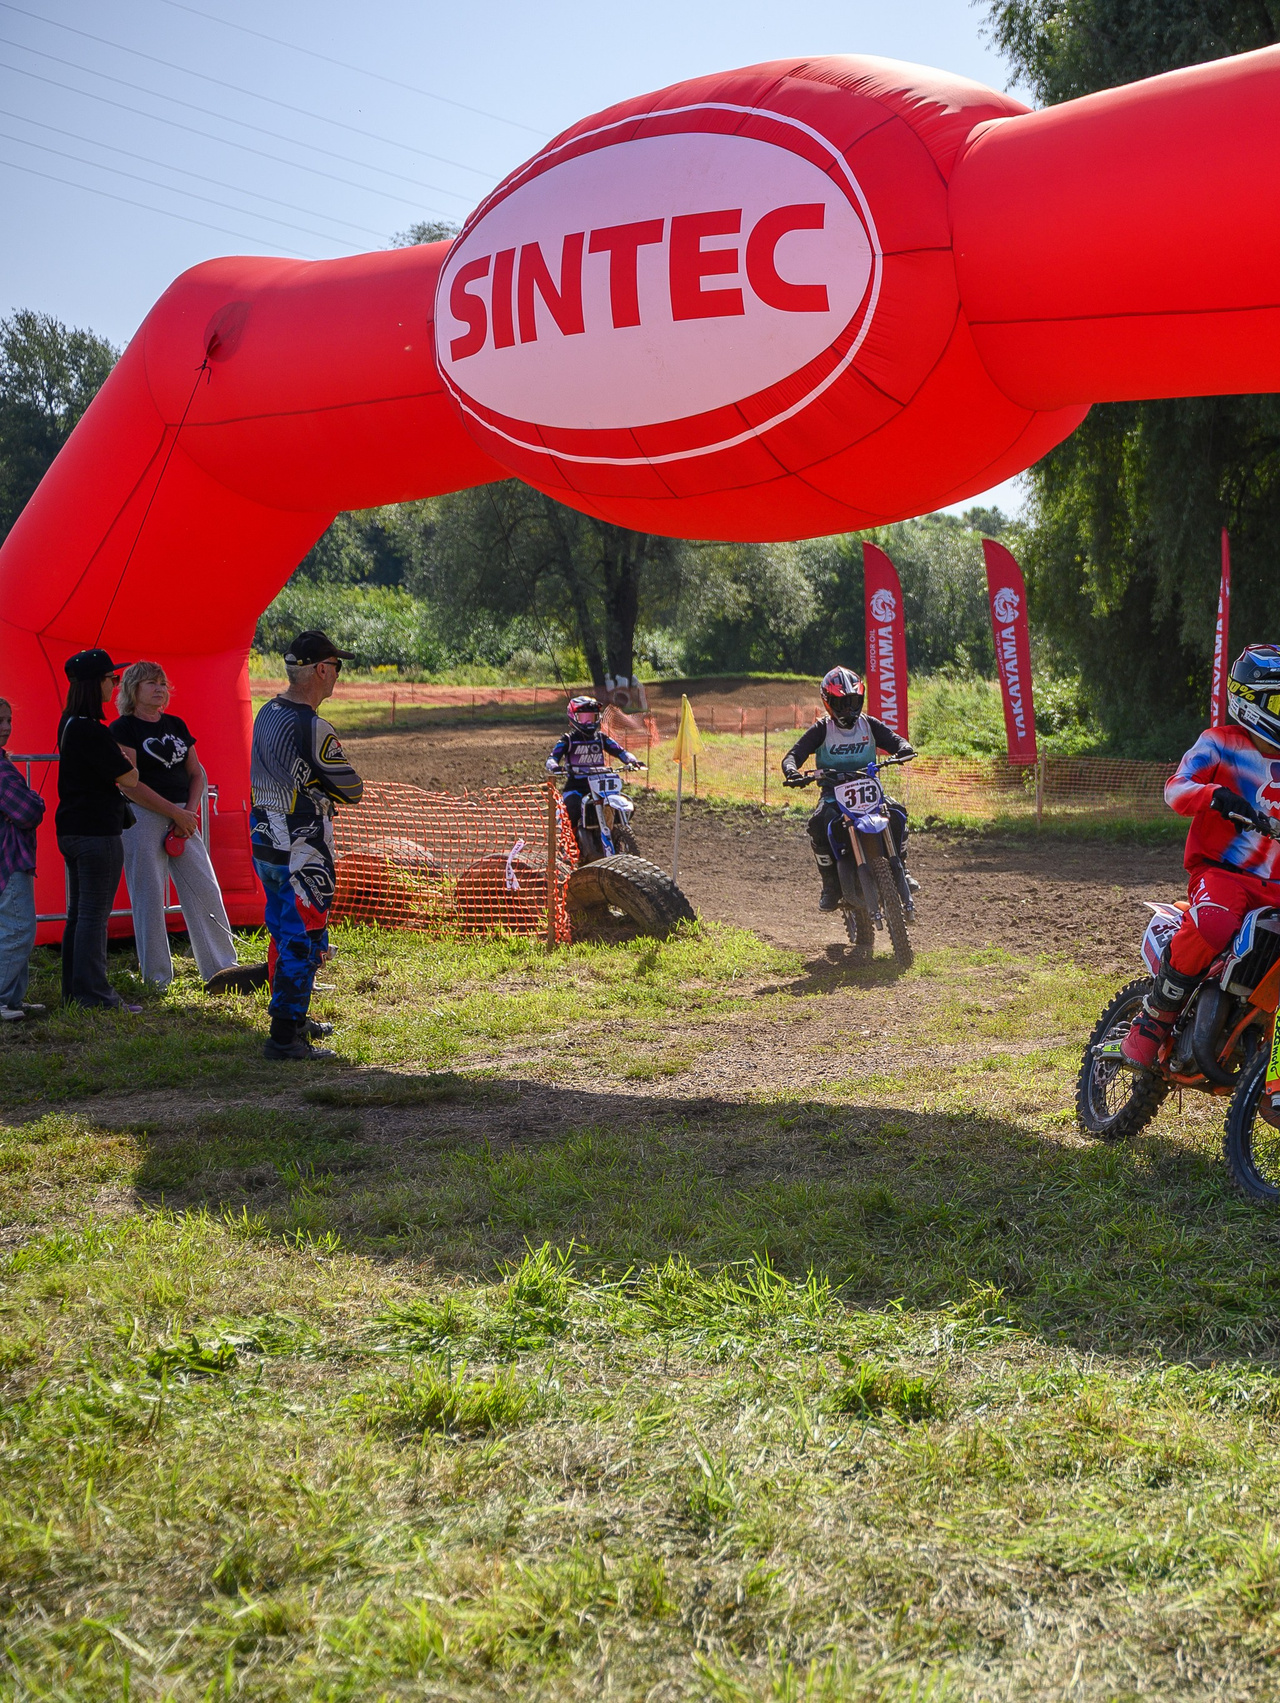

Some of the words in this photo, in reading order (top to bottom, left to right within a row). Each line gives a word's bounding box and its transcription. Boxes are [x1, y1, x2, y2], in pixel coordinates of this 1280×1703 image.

[450, 202, 831, 363] SINTEC
[869, 643, 877, 672] MOTOR
[878, 625, 899, 731] TAKAYAMA
[1001, 625, 1027, 742] TAKAYAMA
[829, 741, 869, 755] LEATT
[844, 785, 877, 809] 313
